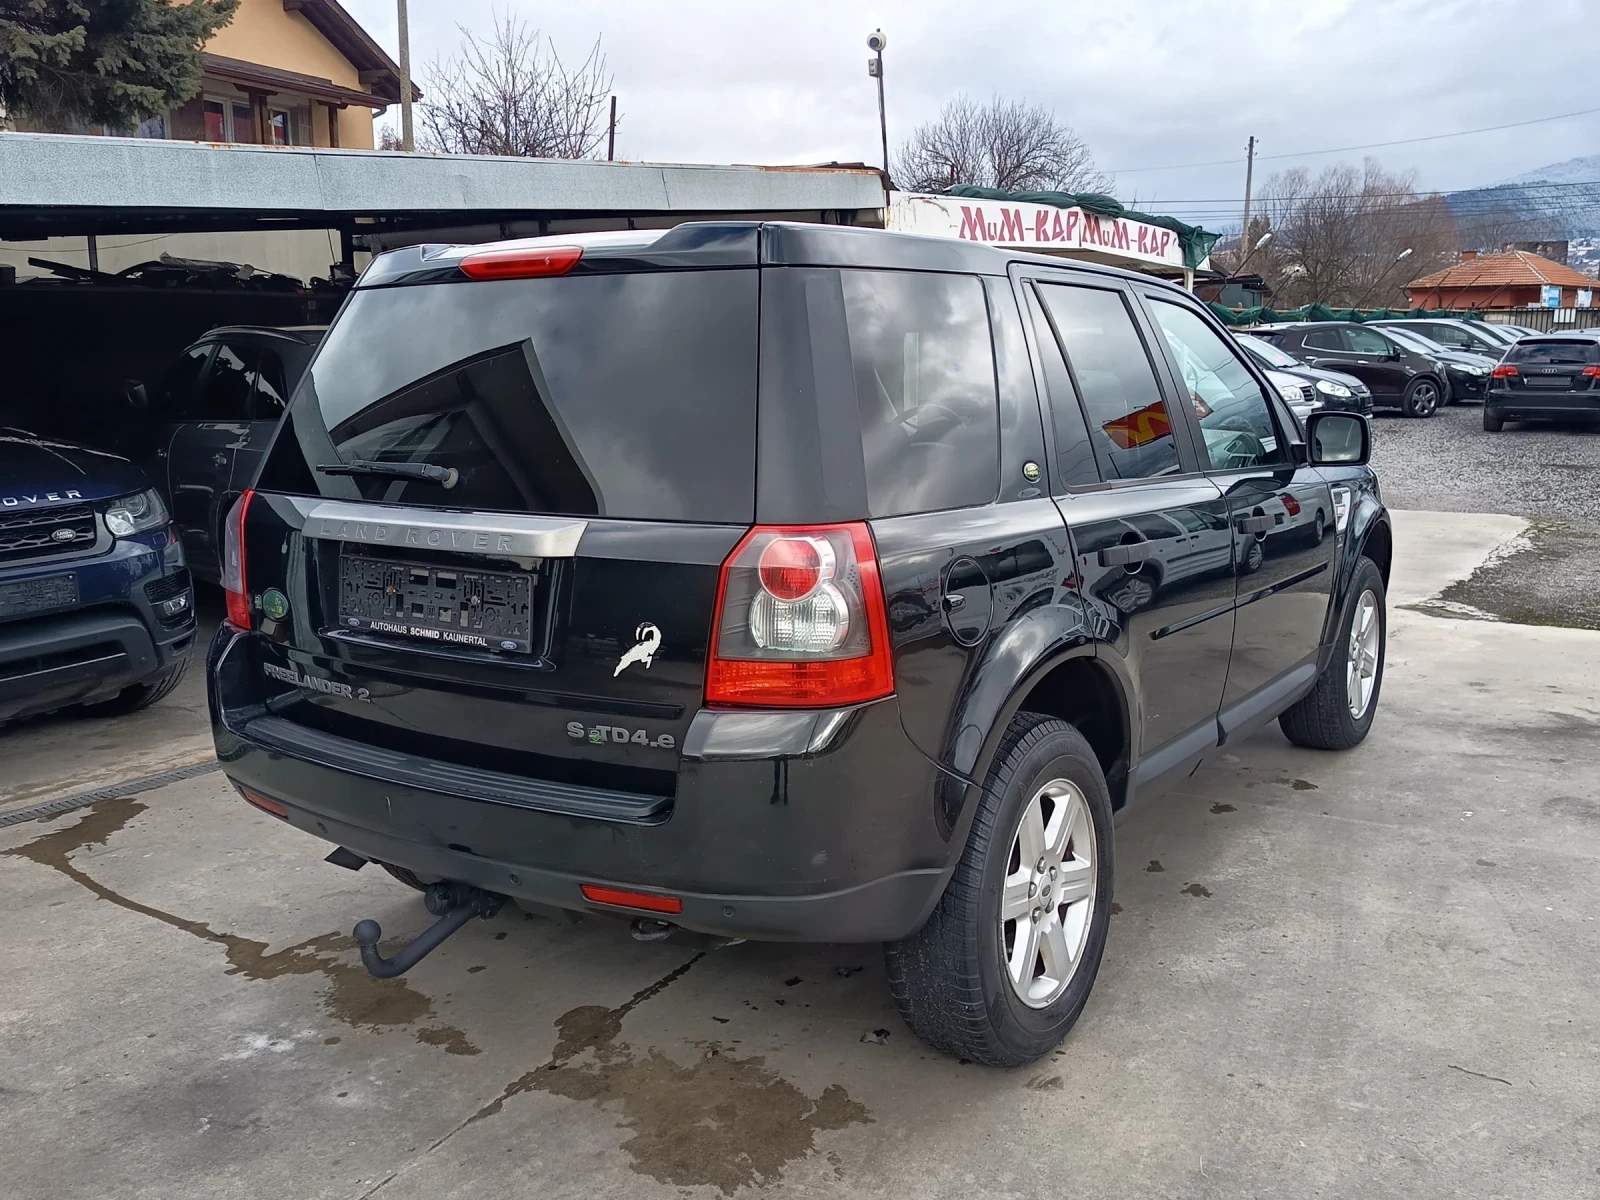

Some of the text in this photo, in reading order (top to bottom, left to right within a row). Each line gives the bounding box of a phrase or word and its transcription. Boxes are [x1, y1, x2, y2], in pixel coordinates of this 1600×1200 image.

[2, 489, 82, 506] OVER
[320, 520, 514, 551] LAND ROVER
[370, 621, 488, 646] AUTOHAUS SCHMID KAUNERTAL
[263, 662, 371, 703] FREELANDER 2
[566, 721, 585, 738] S
